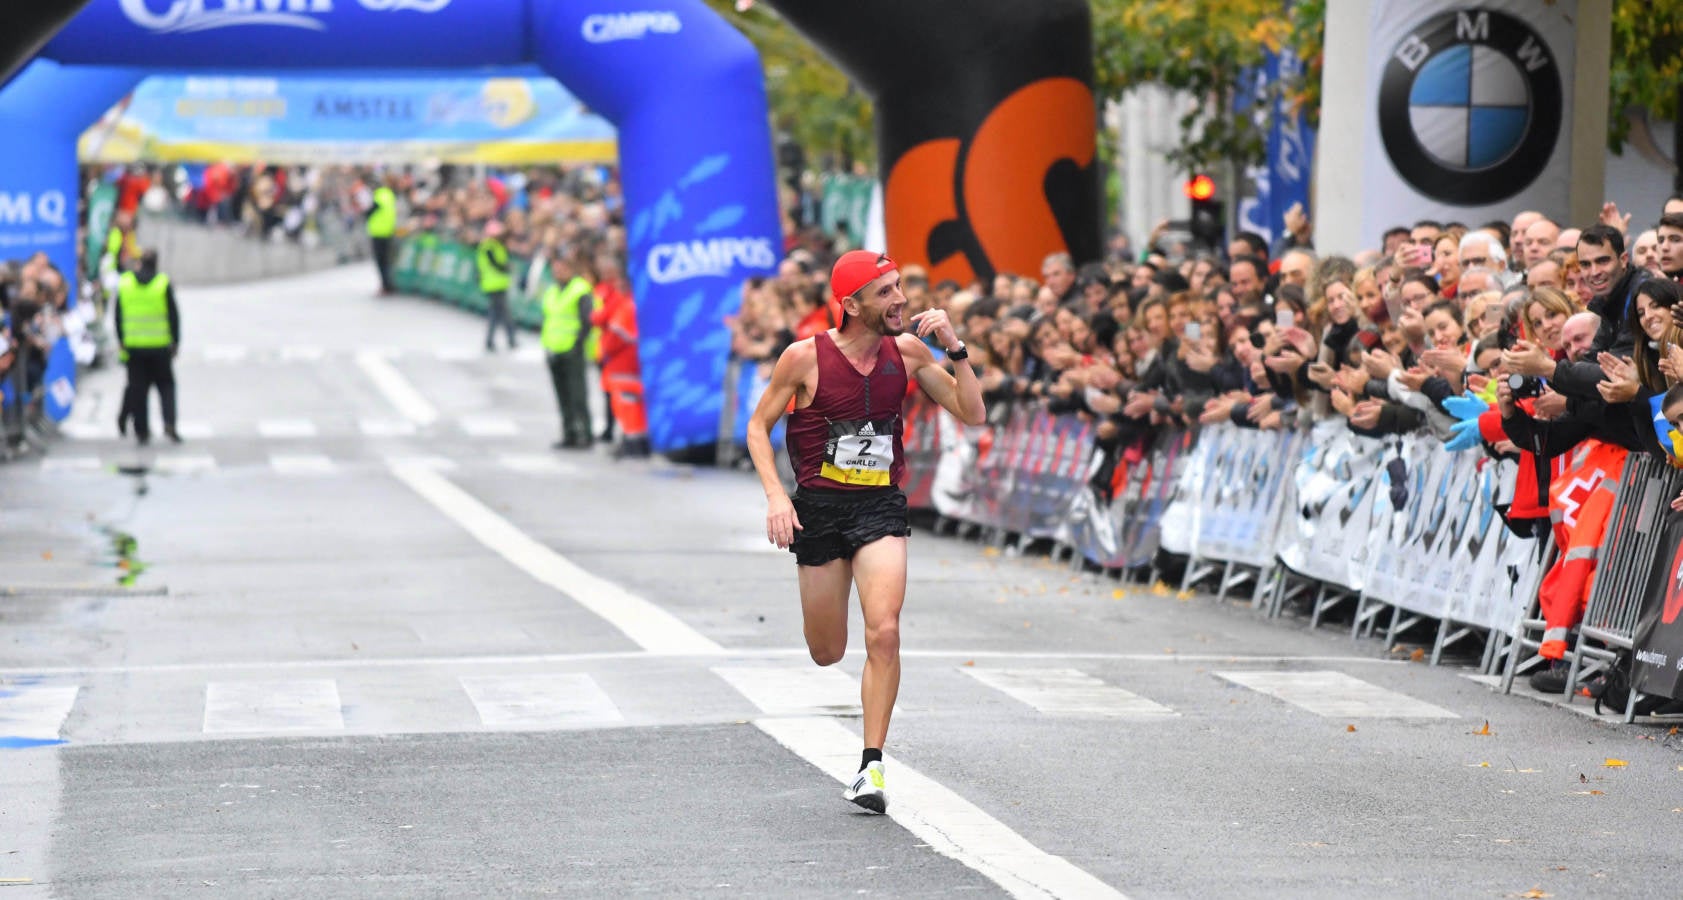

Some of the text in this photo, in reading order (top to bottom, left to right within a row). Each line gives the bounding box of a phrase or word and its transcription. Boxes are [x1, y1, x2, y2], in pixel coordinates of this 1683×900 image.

[581, 11, 682, 43] CAMPOS
[1395, 11, 1548, 71] BMW
[648, 236, 775, 283] CAMPOS
[858, 439, 872, 457] 2
